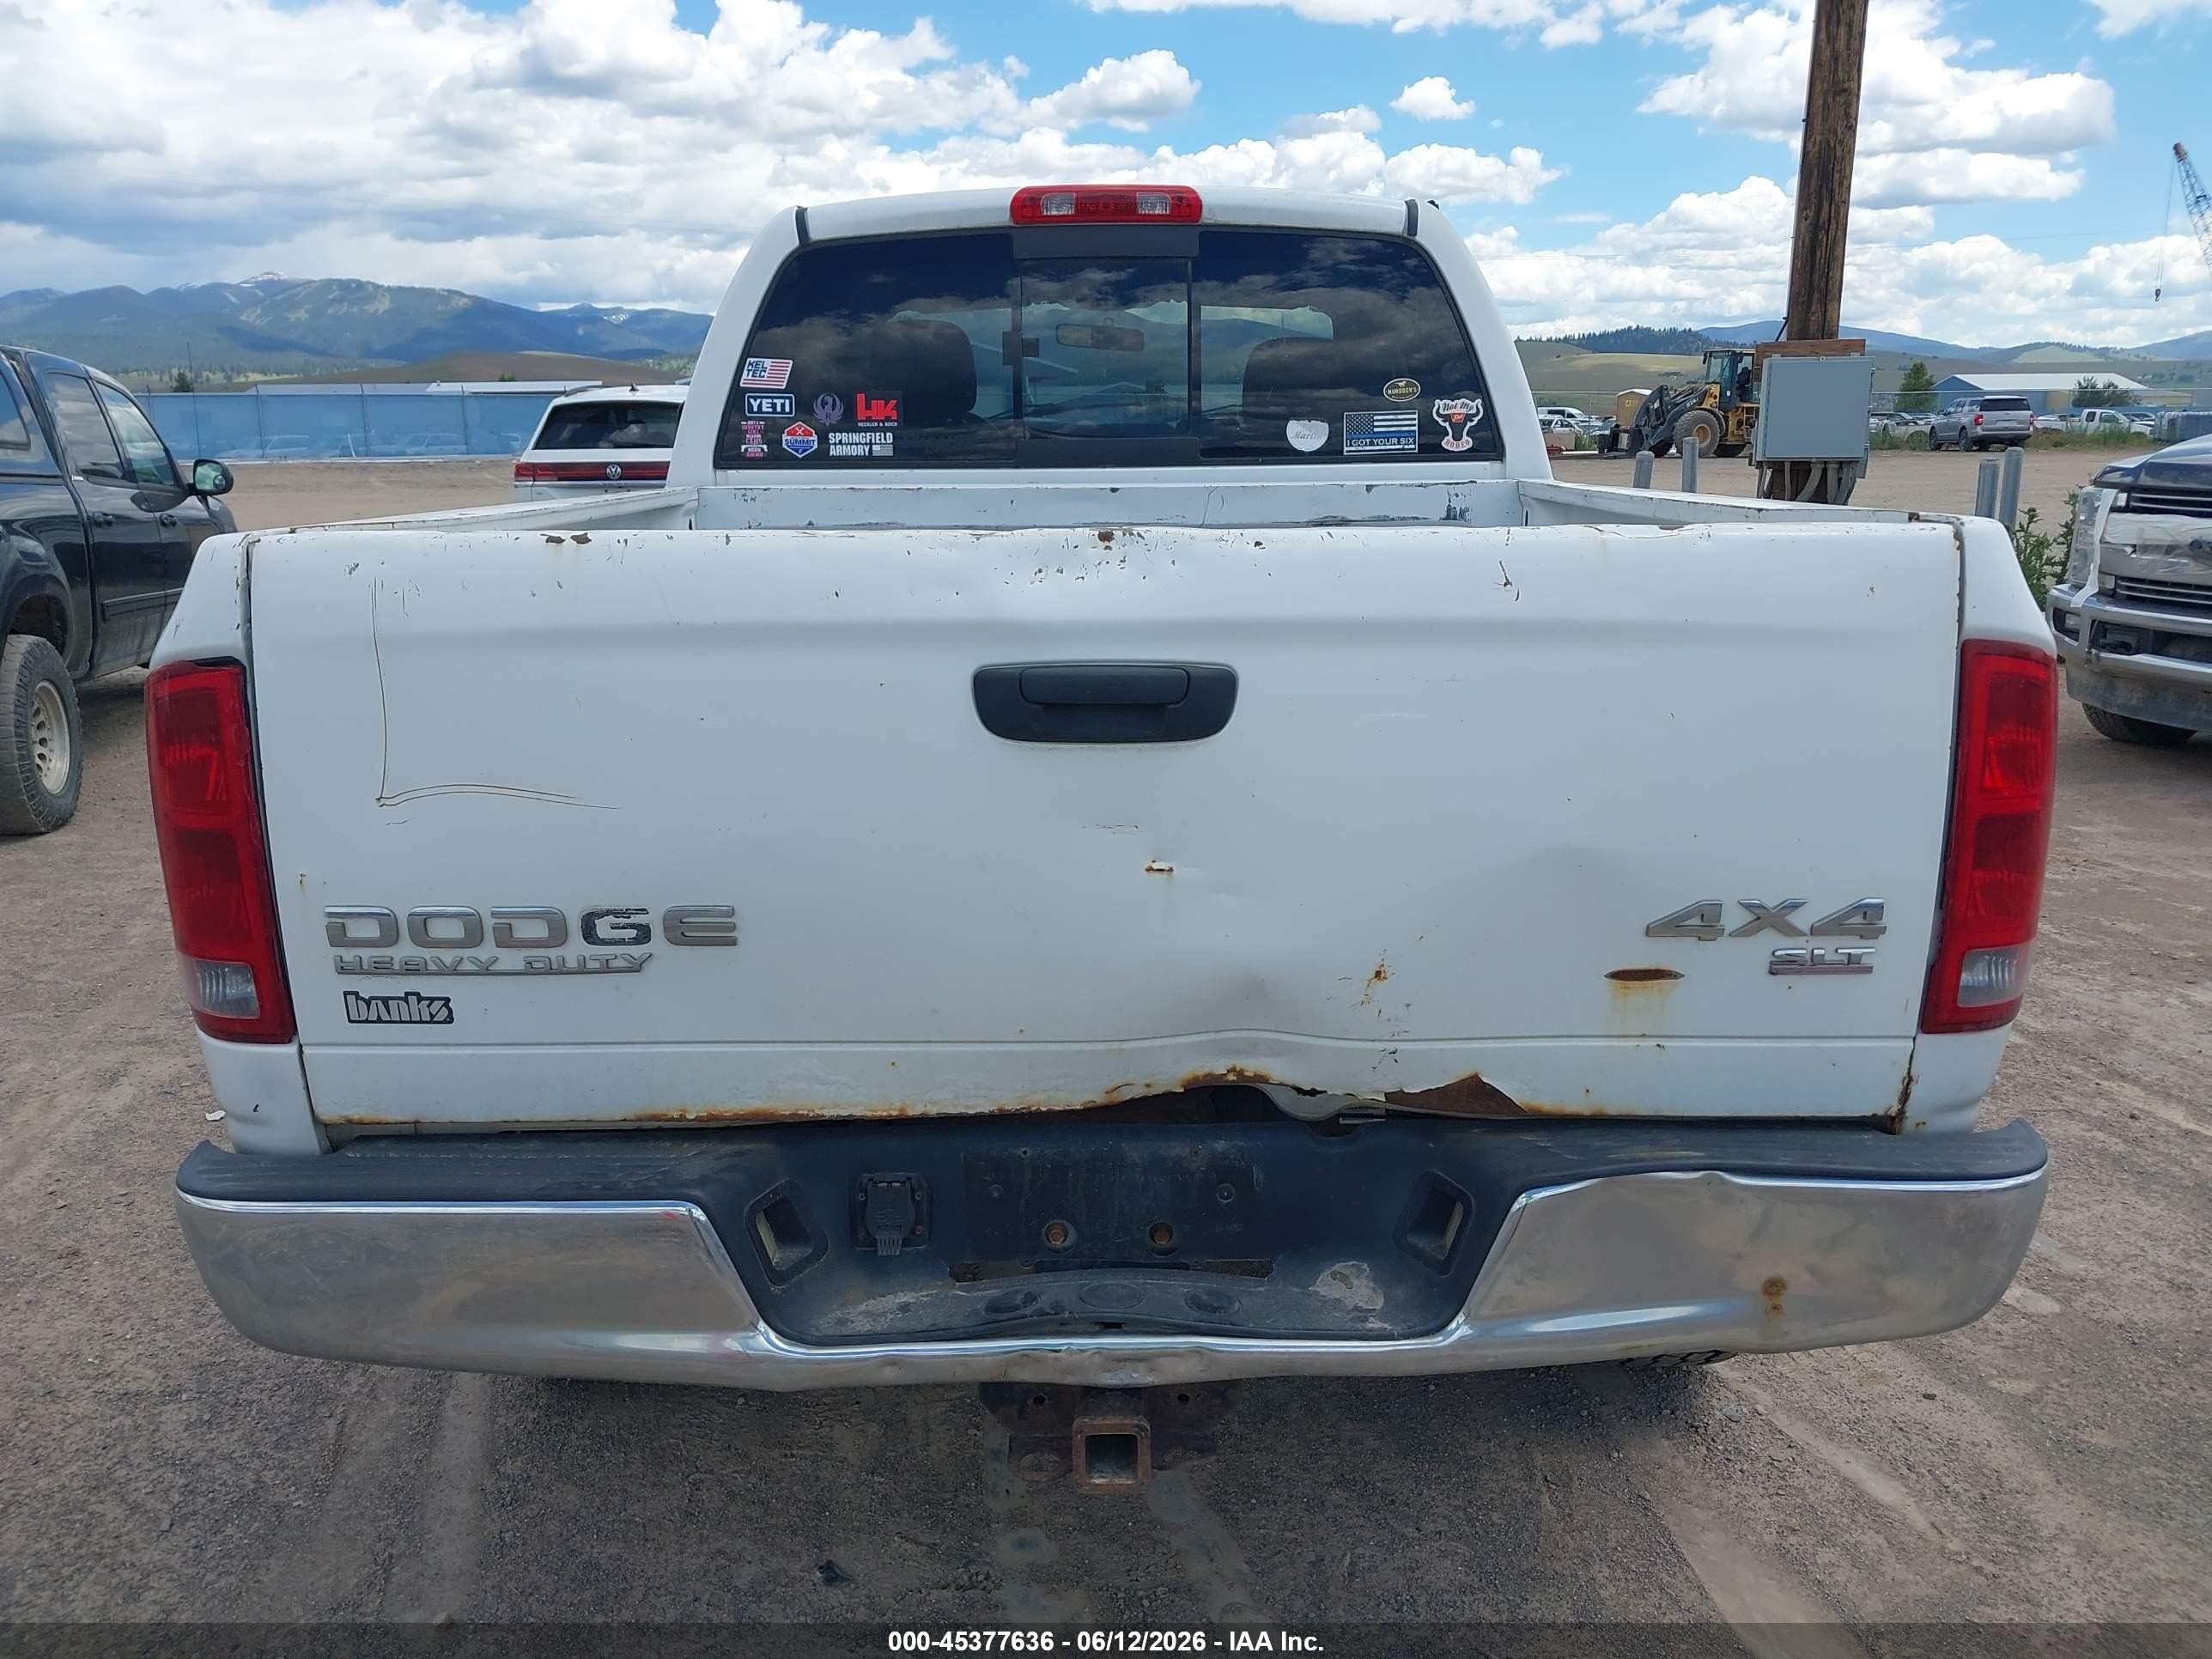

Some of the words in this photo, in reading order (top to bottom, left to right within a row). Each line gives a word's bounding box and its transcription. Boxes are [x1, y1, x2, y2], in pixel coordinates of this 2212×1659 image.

[747, 360, 768, 369] KEL
[746, 369, 767, 379] TEC
[749, 398, 790, 412] YETI
[1443, 402, 1458, 412] Not
[1460, 401, 1474, 412] My
[829, 432, 893, 443] SPRINGFIELD
[1372, 437, 1398, 446] YOUR
[1444, 439, 1470, 448] RODEO
[830, 444, 870, 456] ARMORY
[324, 905, 738, 949] DODGE
[334, 954, 500, 974] HEAVY
[524, 951, 653, 972] DUTY
[1771, 947, 1876, 967] SLT
[346, 993, 452, 1023] banks
